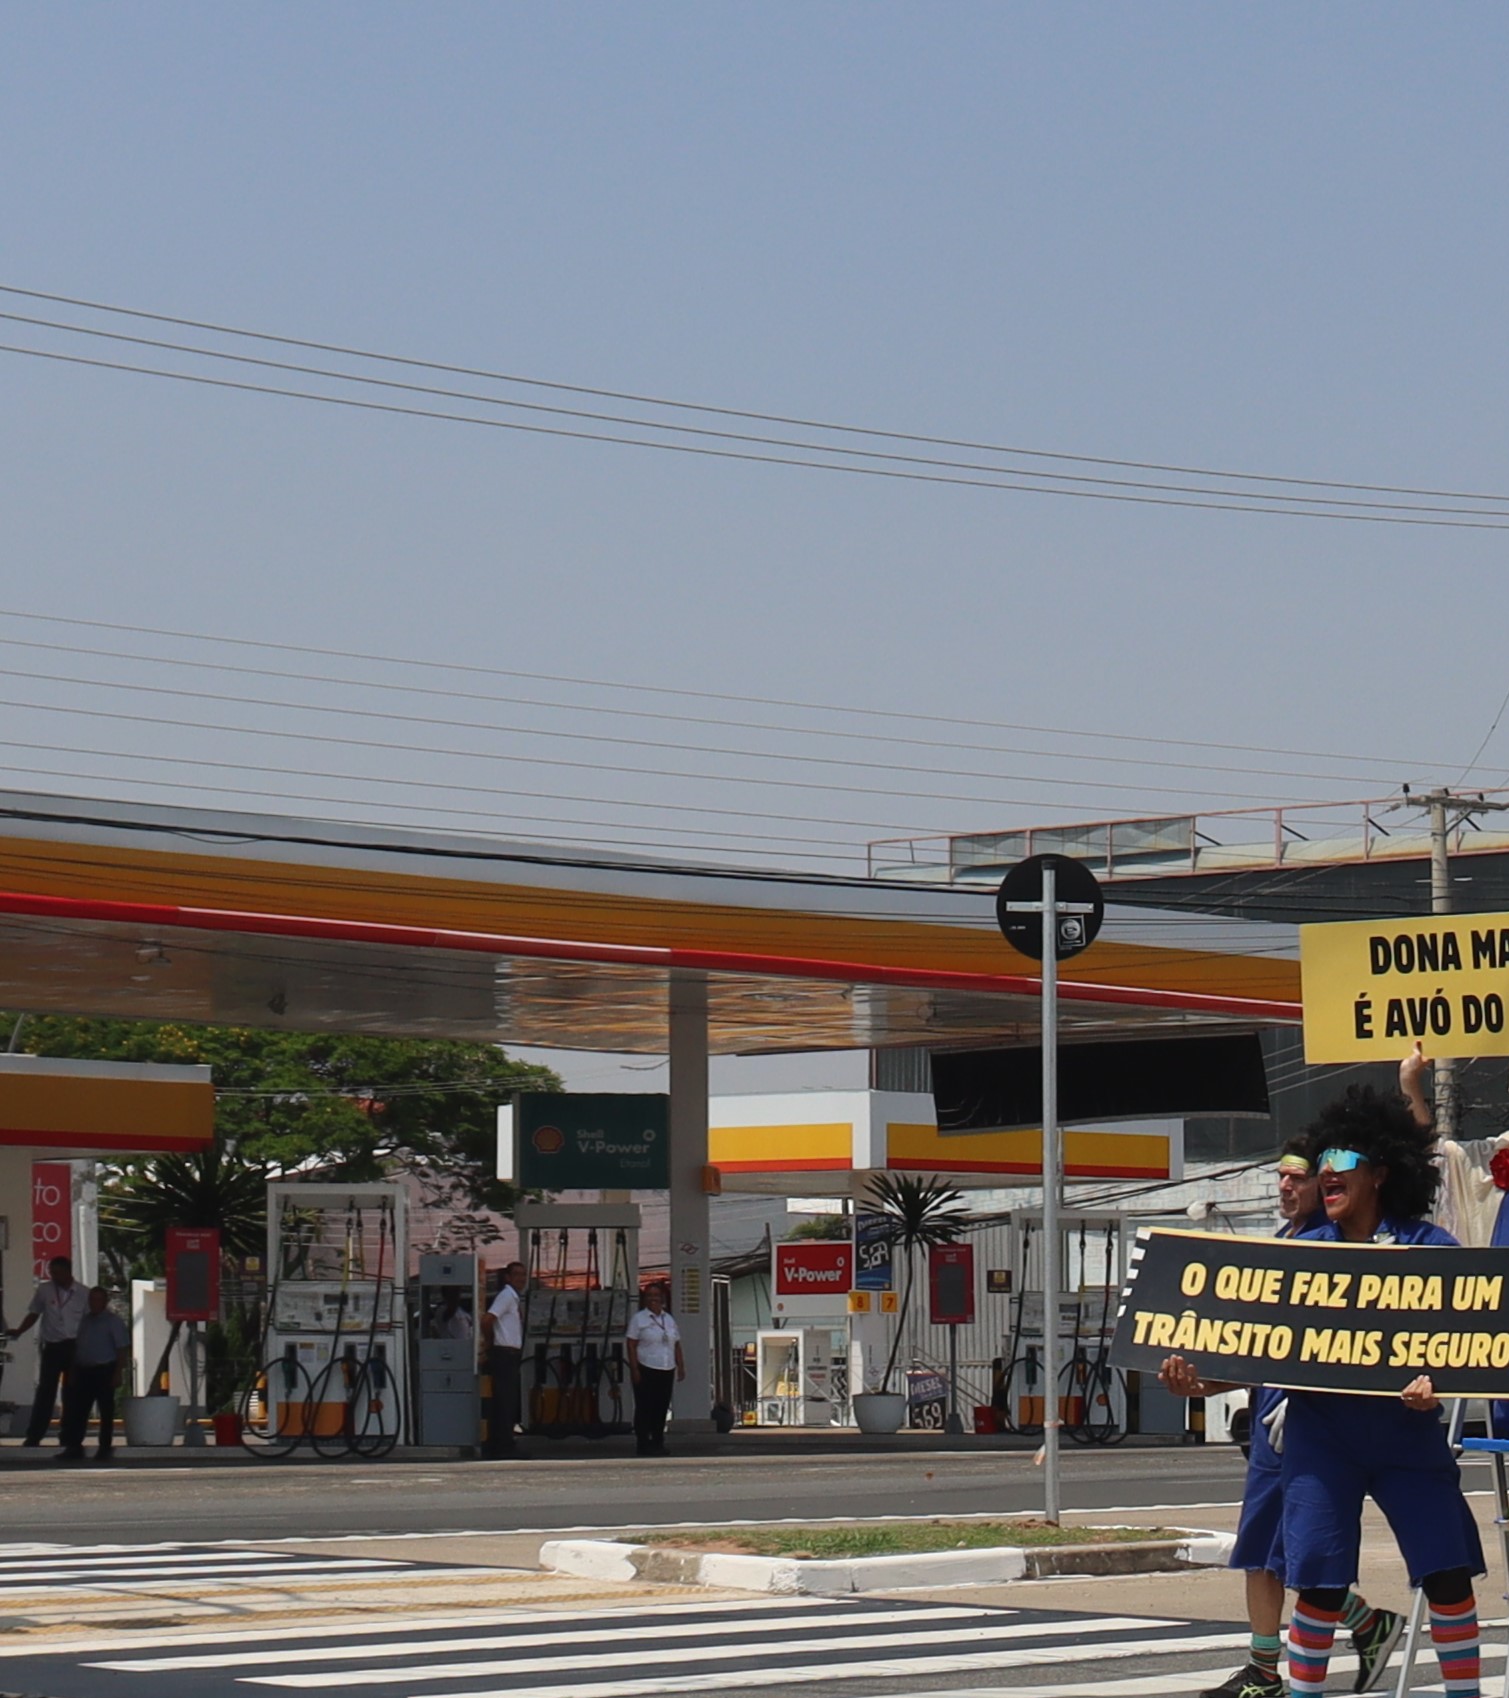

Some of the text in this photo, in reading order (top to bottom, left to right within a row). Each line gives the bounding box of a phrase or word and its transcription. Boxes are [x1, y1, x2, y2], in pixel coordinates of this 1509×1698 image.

[1370, 932, 1462, 974] DONA
[1355, 993, 1373, 1039] É
[1386, 989, 1450, 1037] AVÓ
[1463, 994, 1503, 1033] DO
[576, 1129, 605, 1139] Shell
[577, 1140, 650, 1154] V-Power
[783, 1266, 842, 1283] V-Power
[1182, 1263, 1502, 1310] O QUE FAZ PARA UM
[856, 1295, 865, 1309] 8
[886, 1297, 895, 1309] 7
[1134, 1311, 1292, 1360] TRÂNSITO
[1301, 1328, 1382, 1365] MAIS
